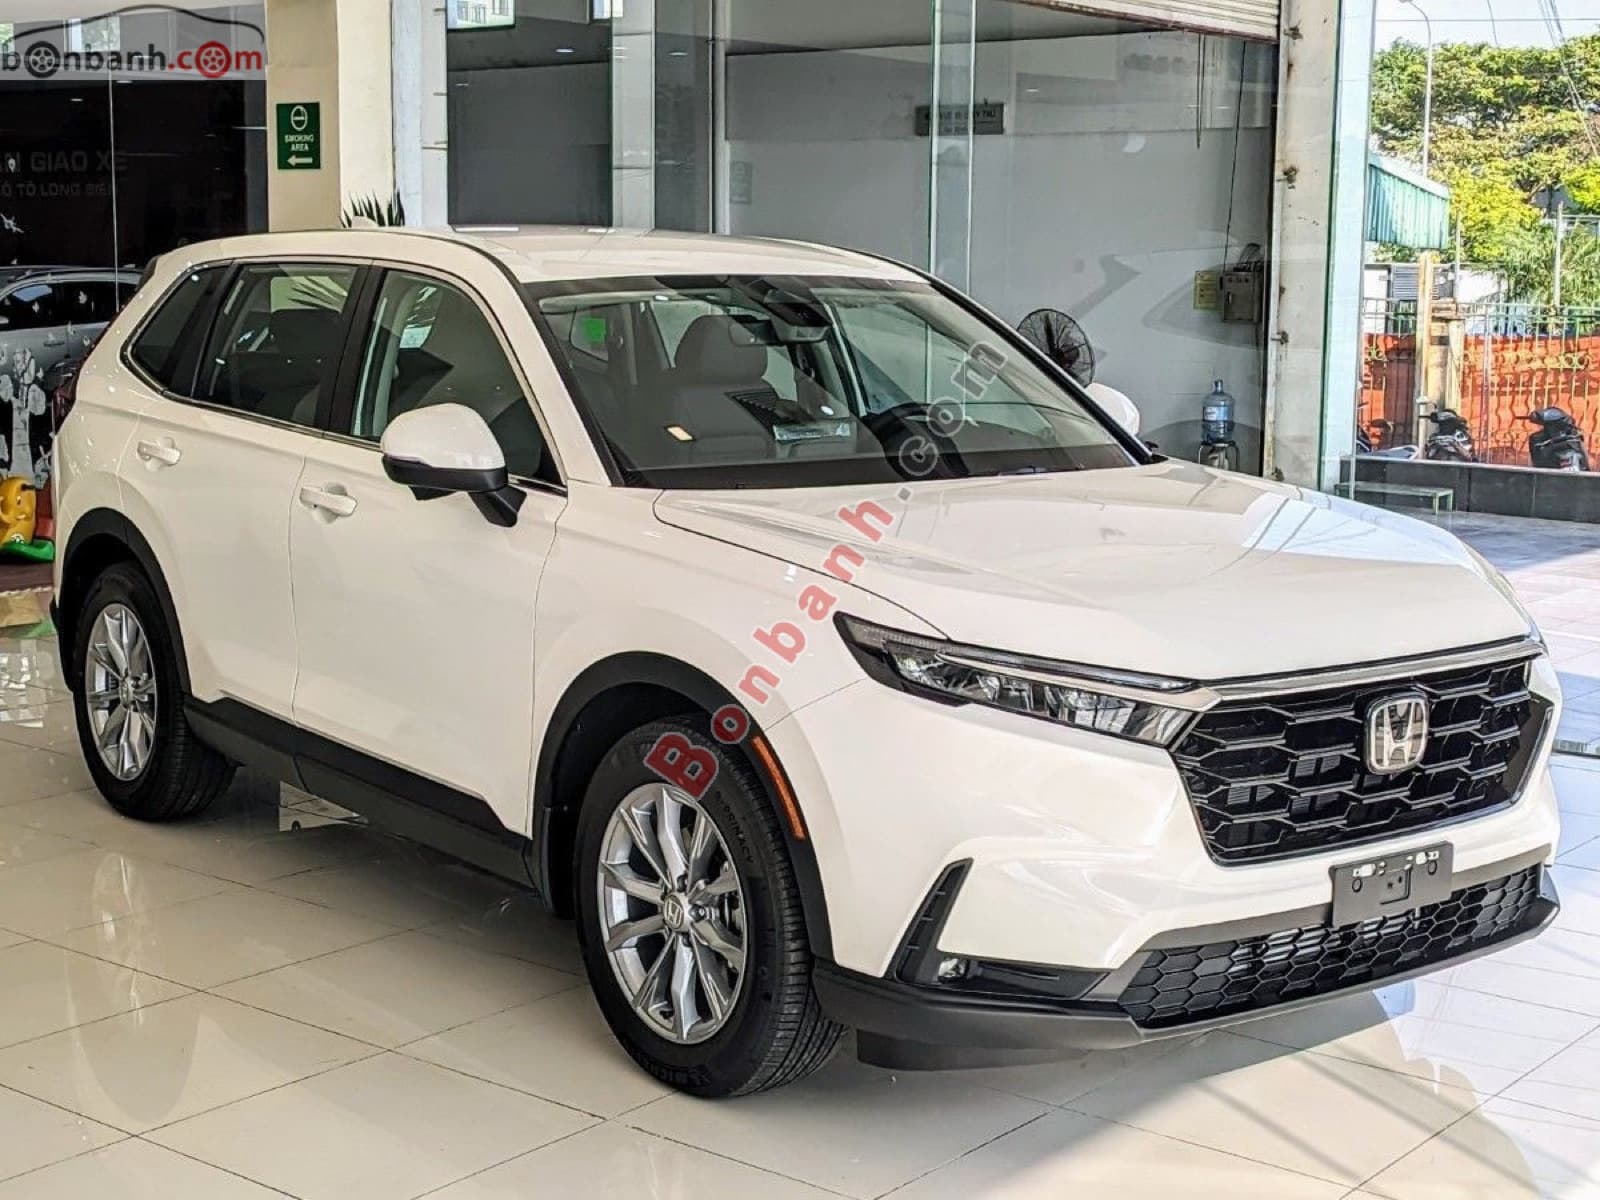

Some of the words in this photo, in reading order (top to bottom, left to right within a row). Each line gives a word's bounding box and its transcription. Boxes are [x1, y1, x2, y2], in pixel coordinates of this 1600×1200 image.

[284, 134, 314, 143] SMOKING
[290, 143, 309, 151] AREA
[30, 150, 88, 173] GIAO
[96, 150, 128, 173] XE
[40, 183, 81, 197] LONG
